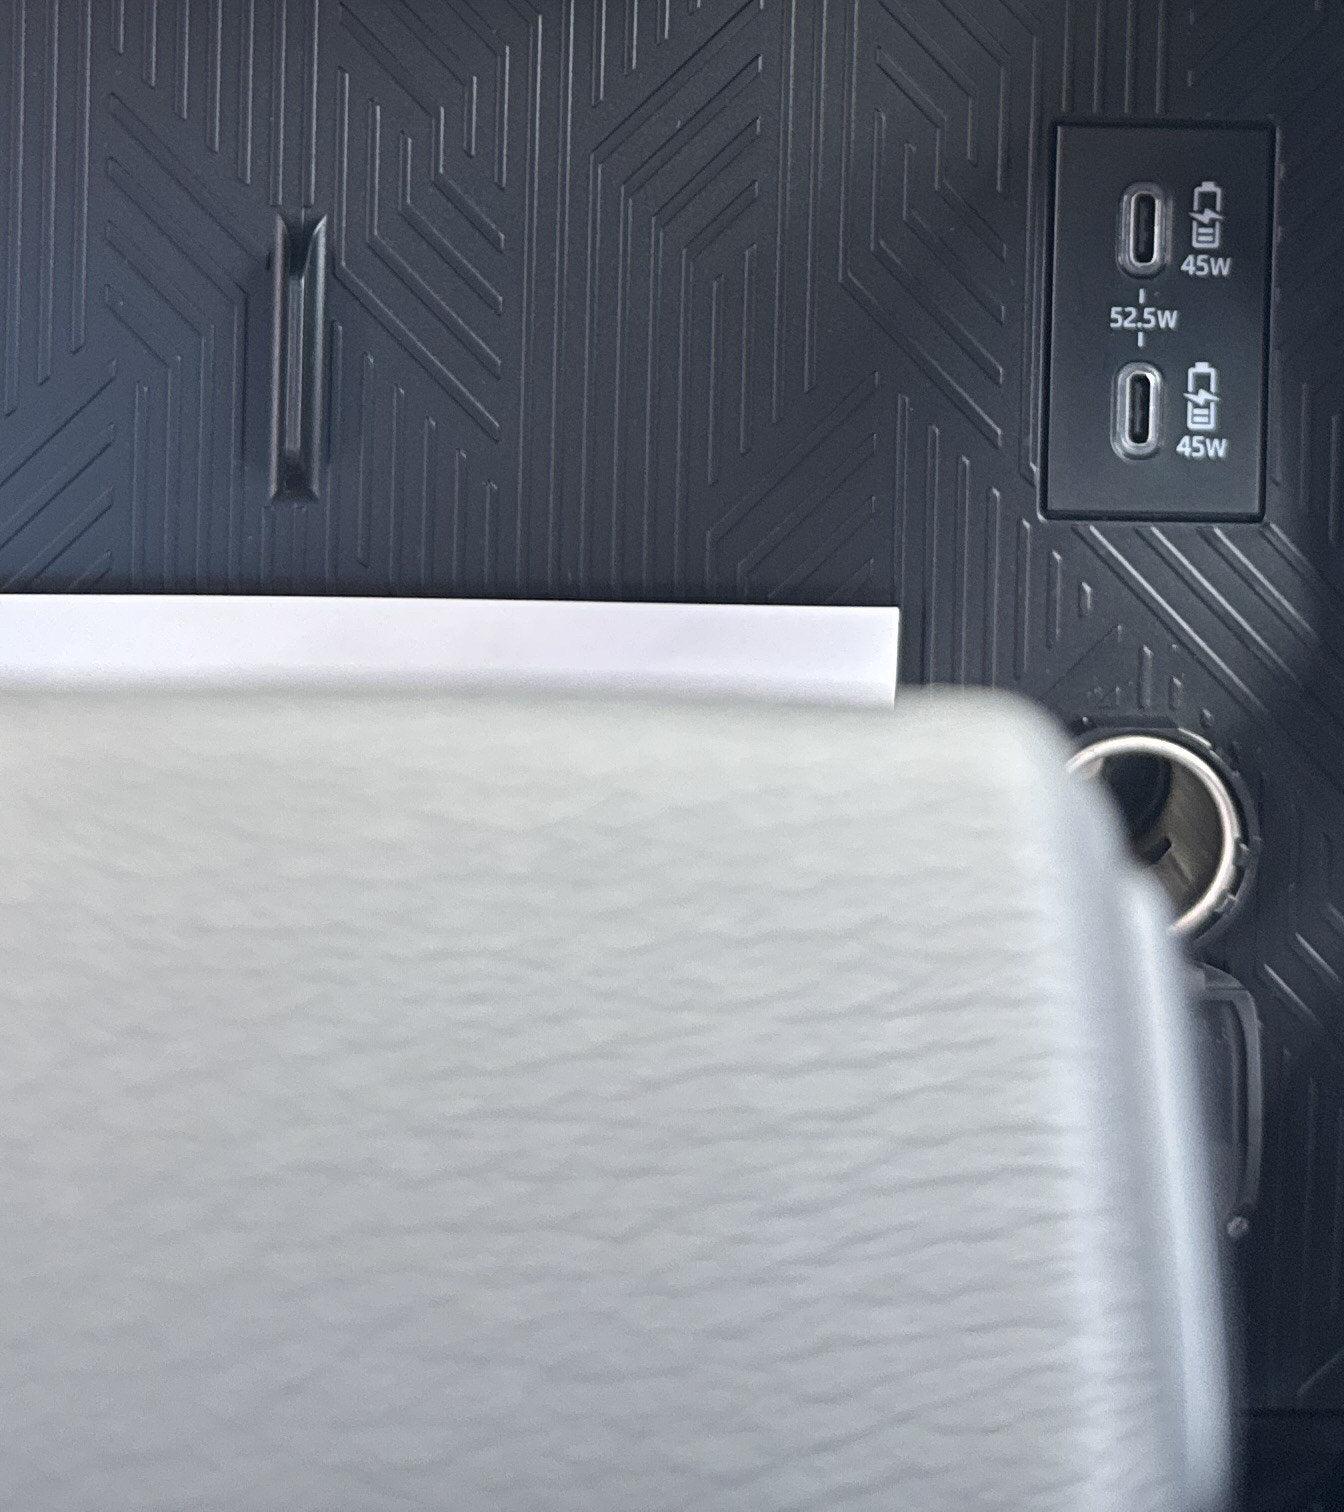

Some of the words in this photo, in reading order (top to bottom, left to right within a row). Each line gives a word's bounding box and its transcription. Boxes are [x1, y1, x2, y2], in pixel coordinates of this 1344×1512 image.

[1180, 254, 1231, 277] 45W
[1110, 306, 1178, 329] 52.5W
[1176, 435, 1228, 458] 45W
